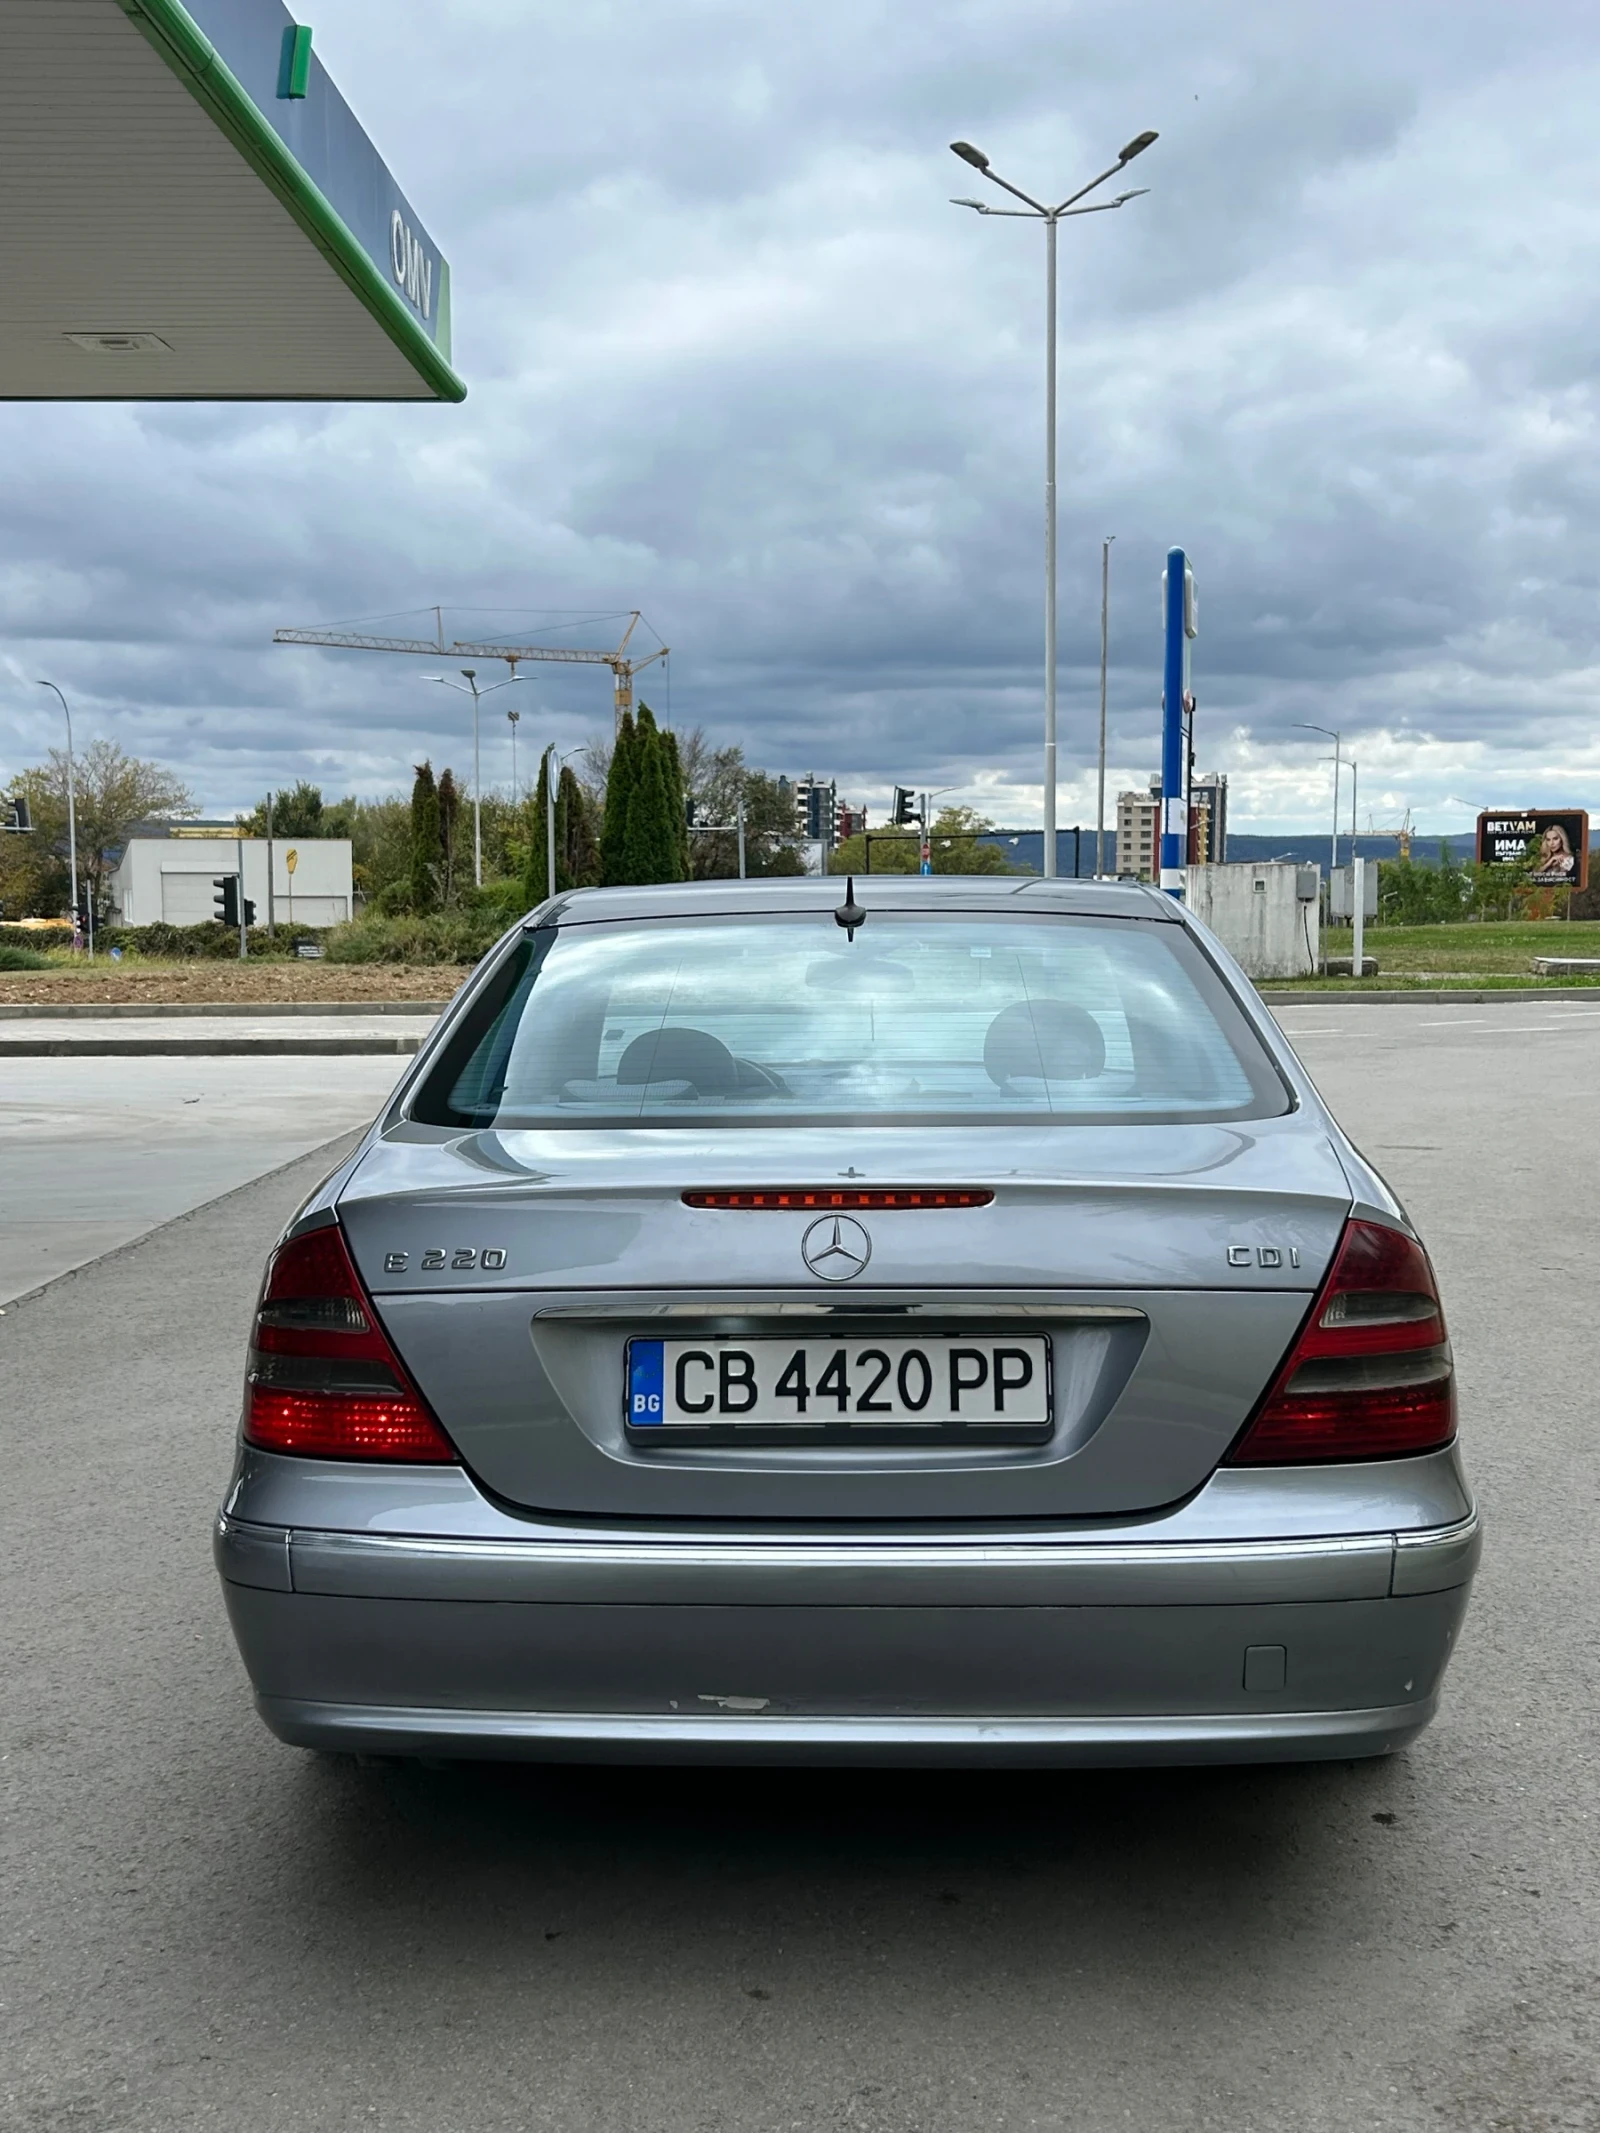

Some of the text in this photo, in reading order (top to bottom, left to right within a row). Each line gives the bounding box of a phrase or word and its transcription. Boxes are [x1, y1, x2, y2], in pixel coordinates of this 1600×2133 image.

[1495, 839, 1527, 851] ИМА
[384, 1247, 508, 1273] E 220
[1227, 1245, 1300, 1268] CDI
[675, 1348, 1033, 1413] CB 4420 PP
[634, 1394, 660, 1413] BG
